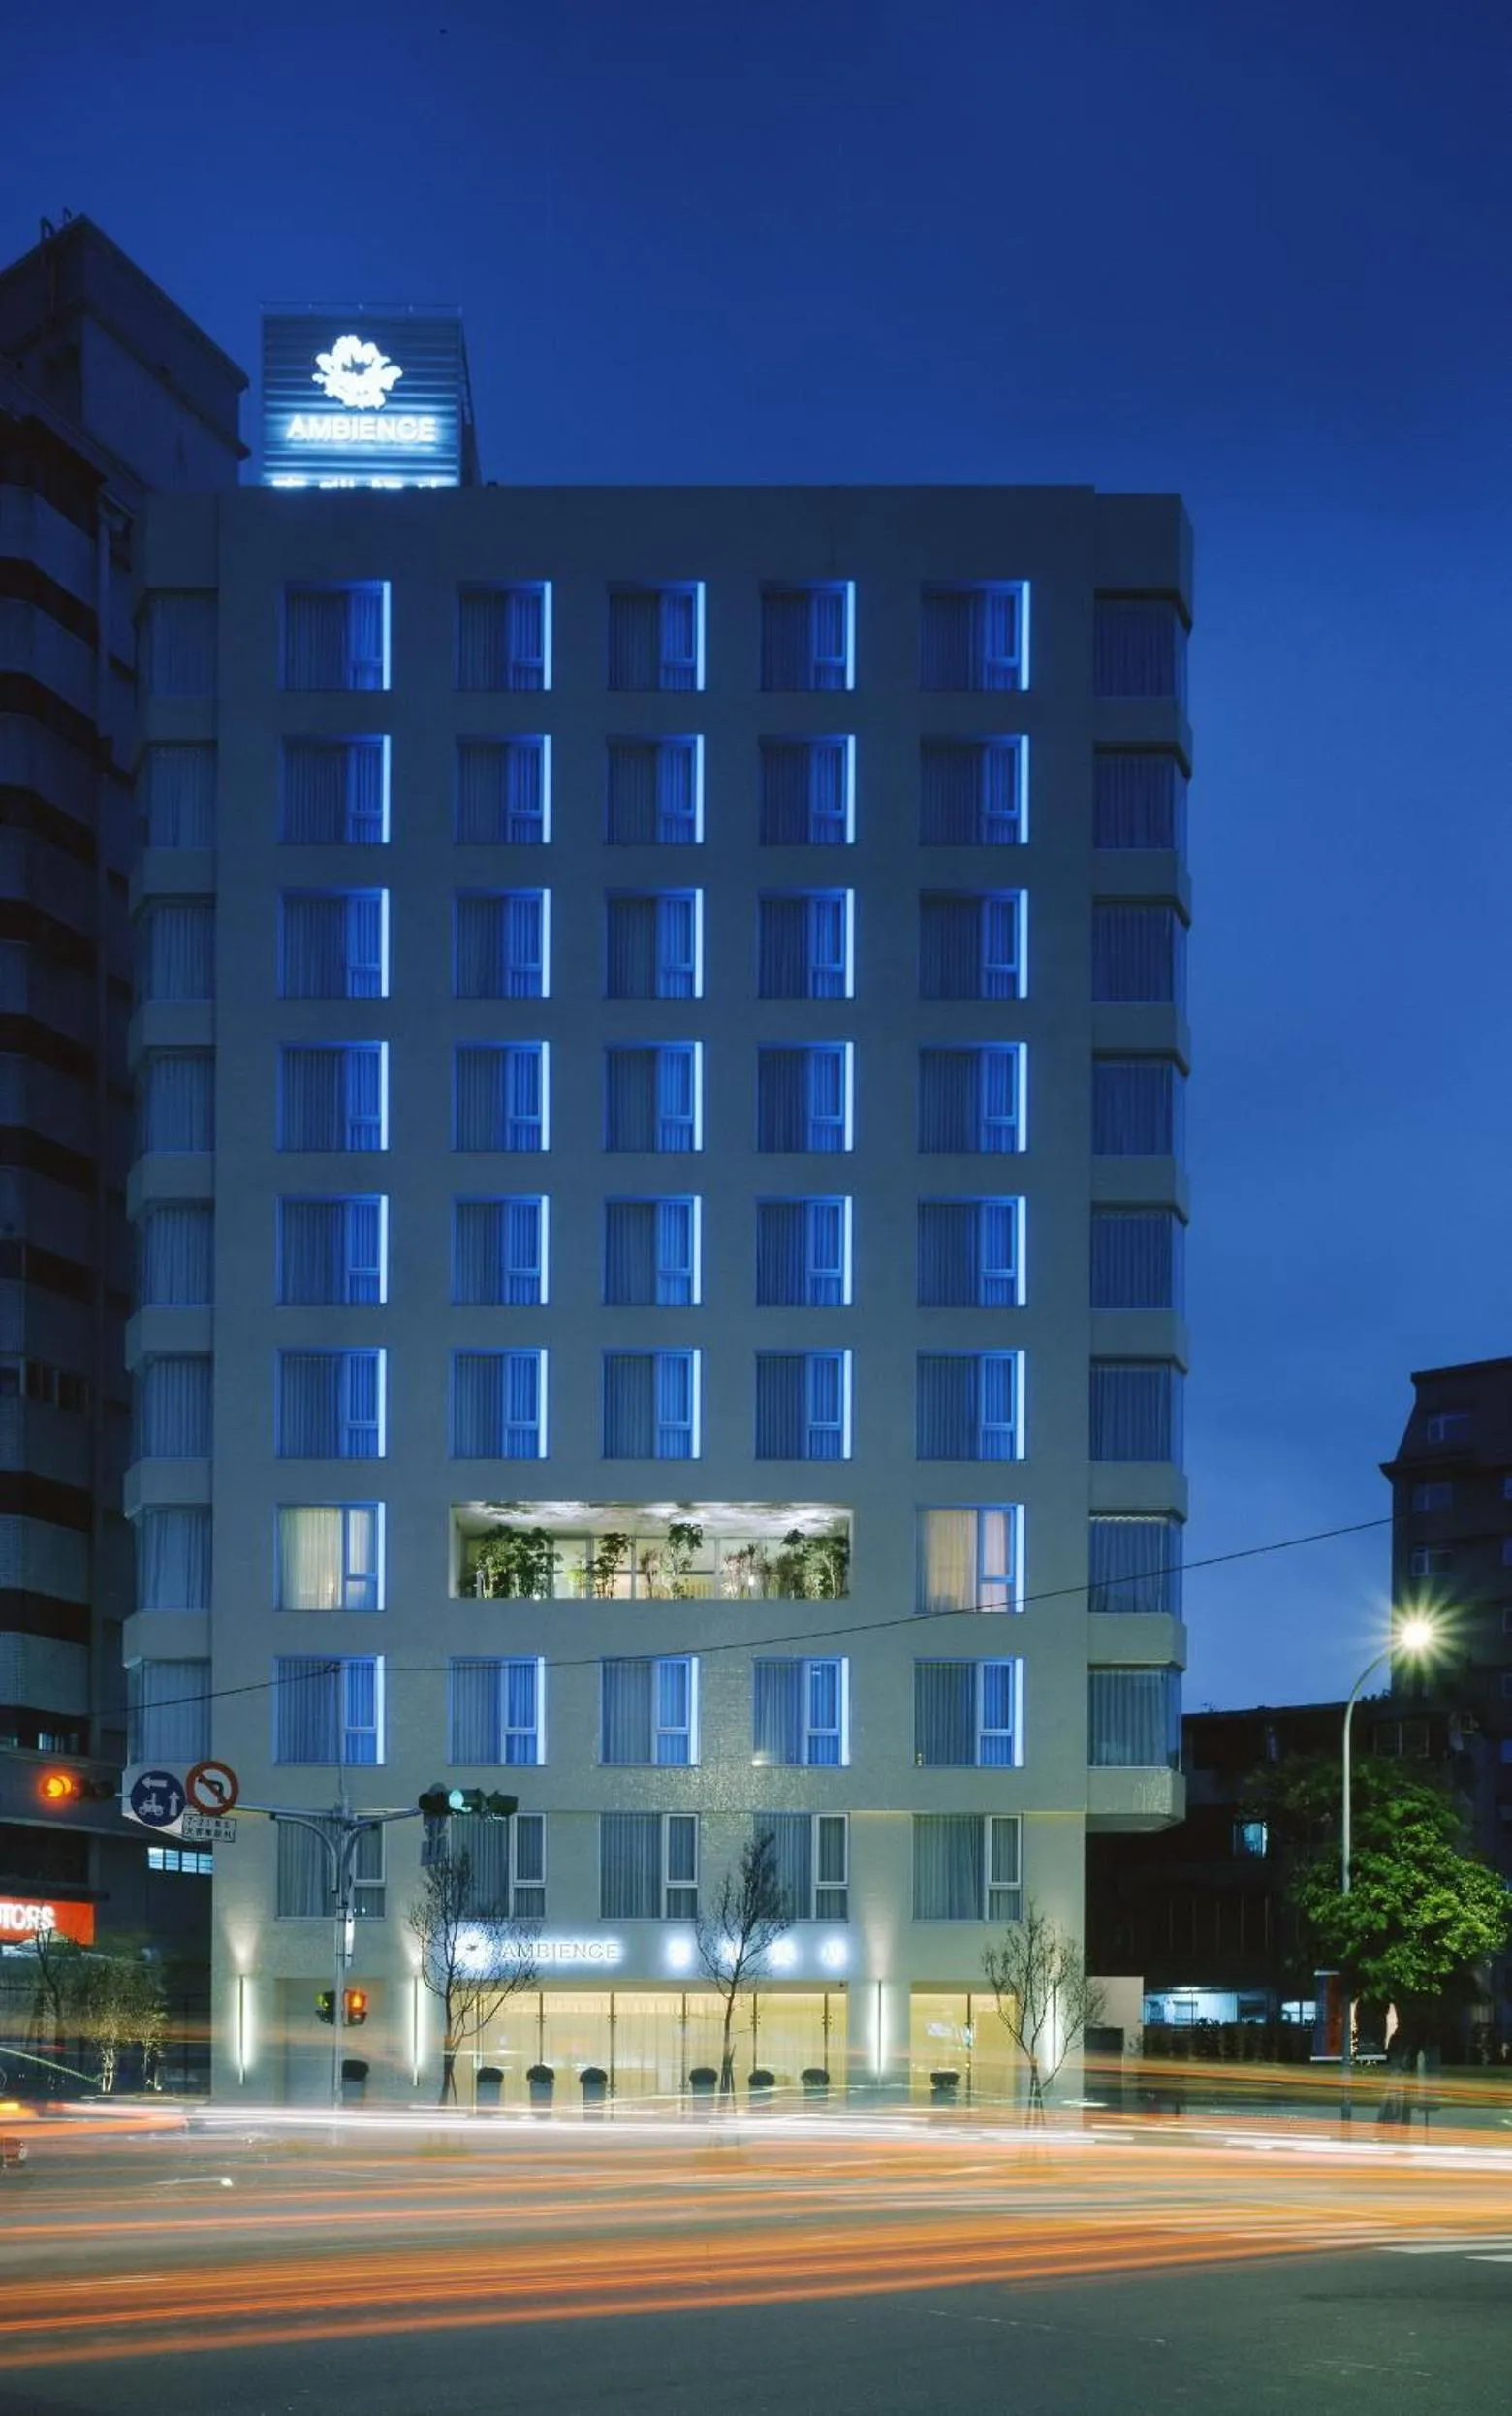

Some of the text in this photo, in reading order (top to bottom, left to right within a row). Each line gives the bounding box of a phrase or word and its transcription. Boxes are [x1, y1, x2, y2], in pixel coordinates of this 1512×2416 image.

[287, 413, 437, 442] AMBIENCE
[0, 1903, 55, 1931] TORS
[502, 1942, 617, 1959] AMBIENCE
